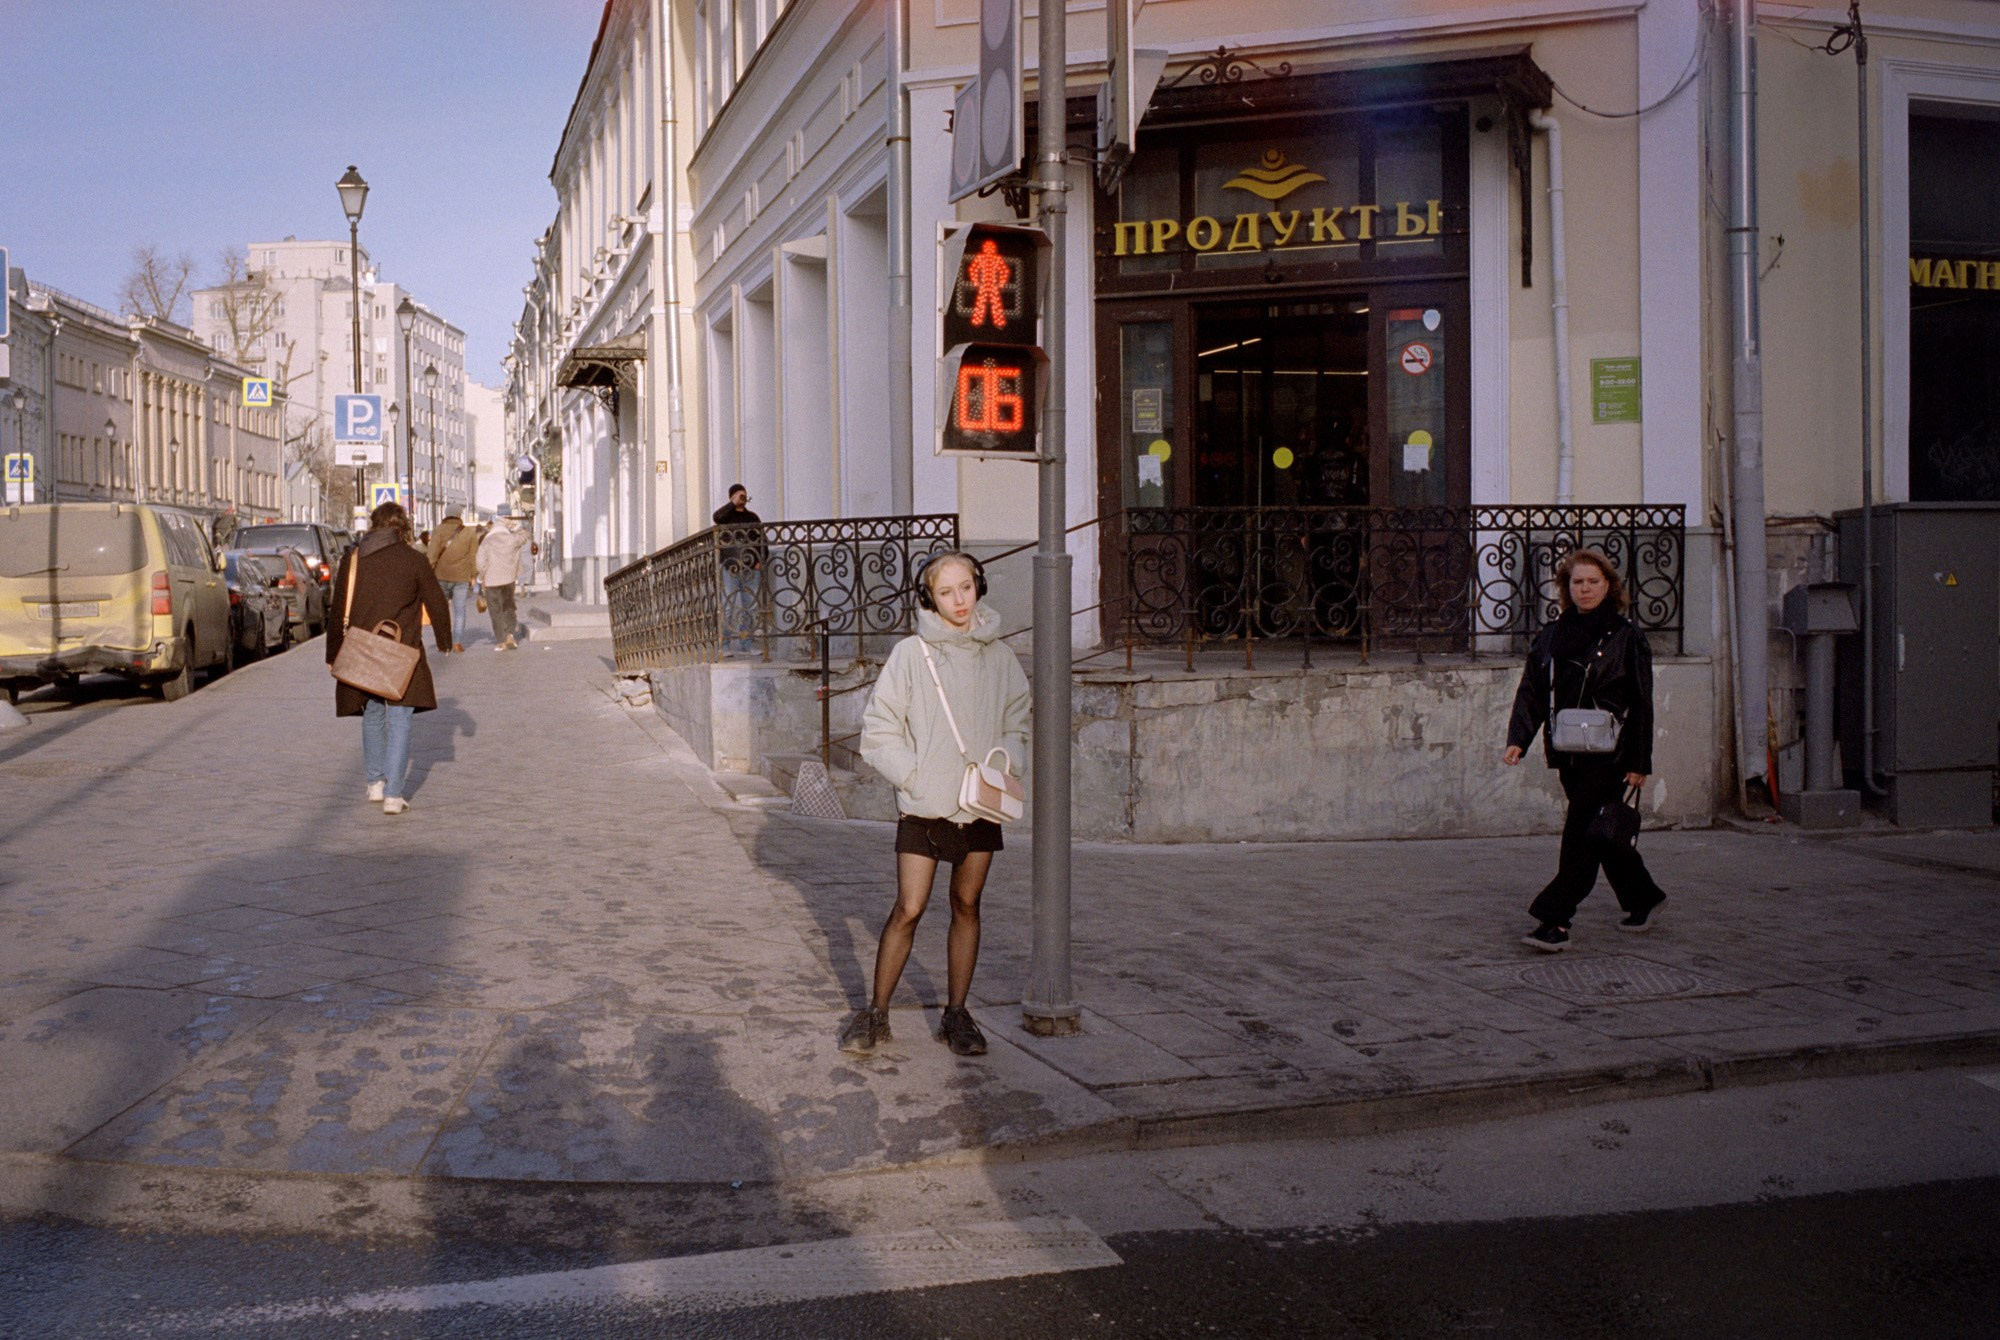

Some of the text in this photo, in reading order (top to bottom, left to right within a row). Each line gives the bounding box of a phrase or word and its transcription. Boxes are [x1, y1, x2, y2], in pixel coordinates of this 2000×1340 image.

[1114, 200, 1440, 255] ПРОДУКТЫ
[347, 399, 374, 436] P
[959, 366, 1023, 430] 06
